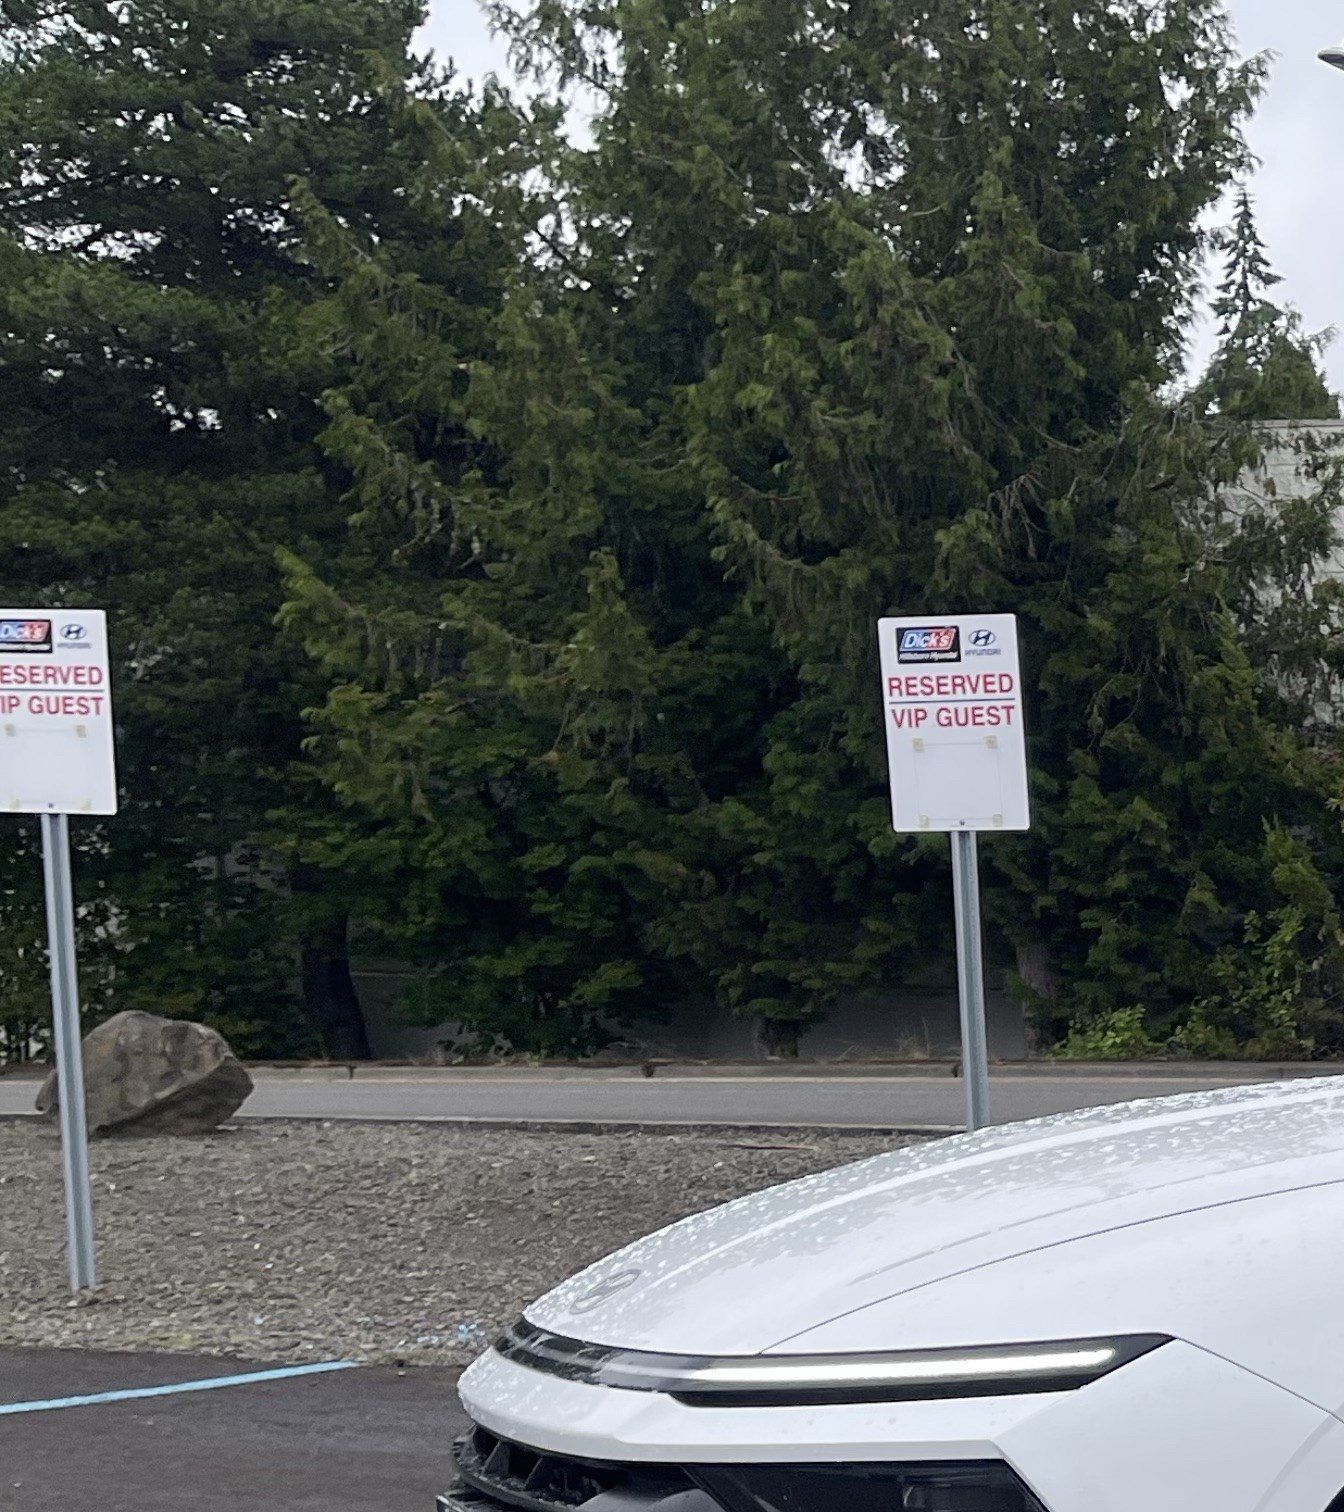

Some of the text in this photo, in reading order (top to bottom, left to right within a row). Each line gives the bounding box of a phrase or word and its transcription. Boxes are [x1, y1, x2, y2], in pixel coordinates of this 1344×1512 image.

[0, 663, 102, 685] ESERVED
[887, 672, 1014, 697] RESERVED
[28, 695, 103, 715] GUEST
[891, 704, 1015, 728] VIP GUEST
